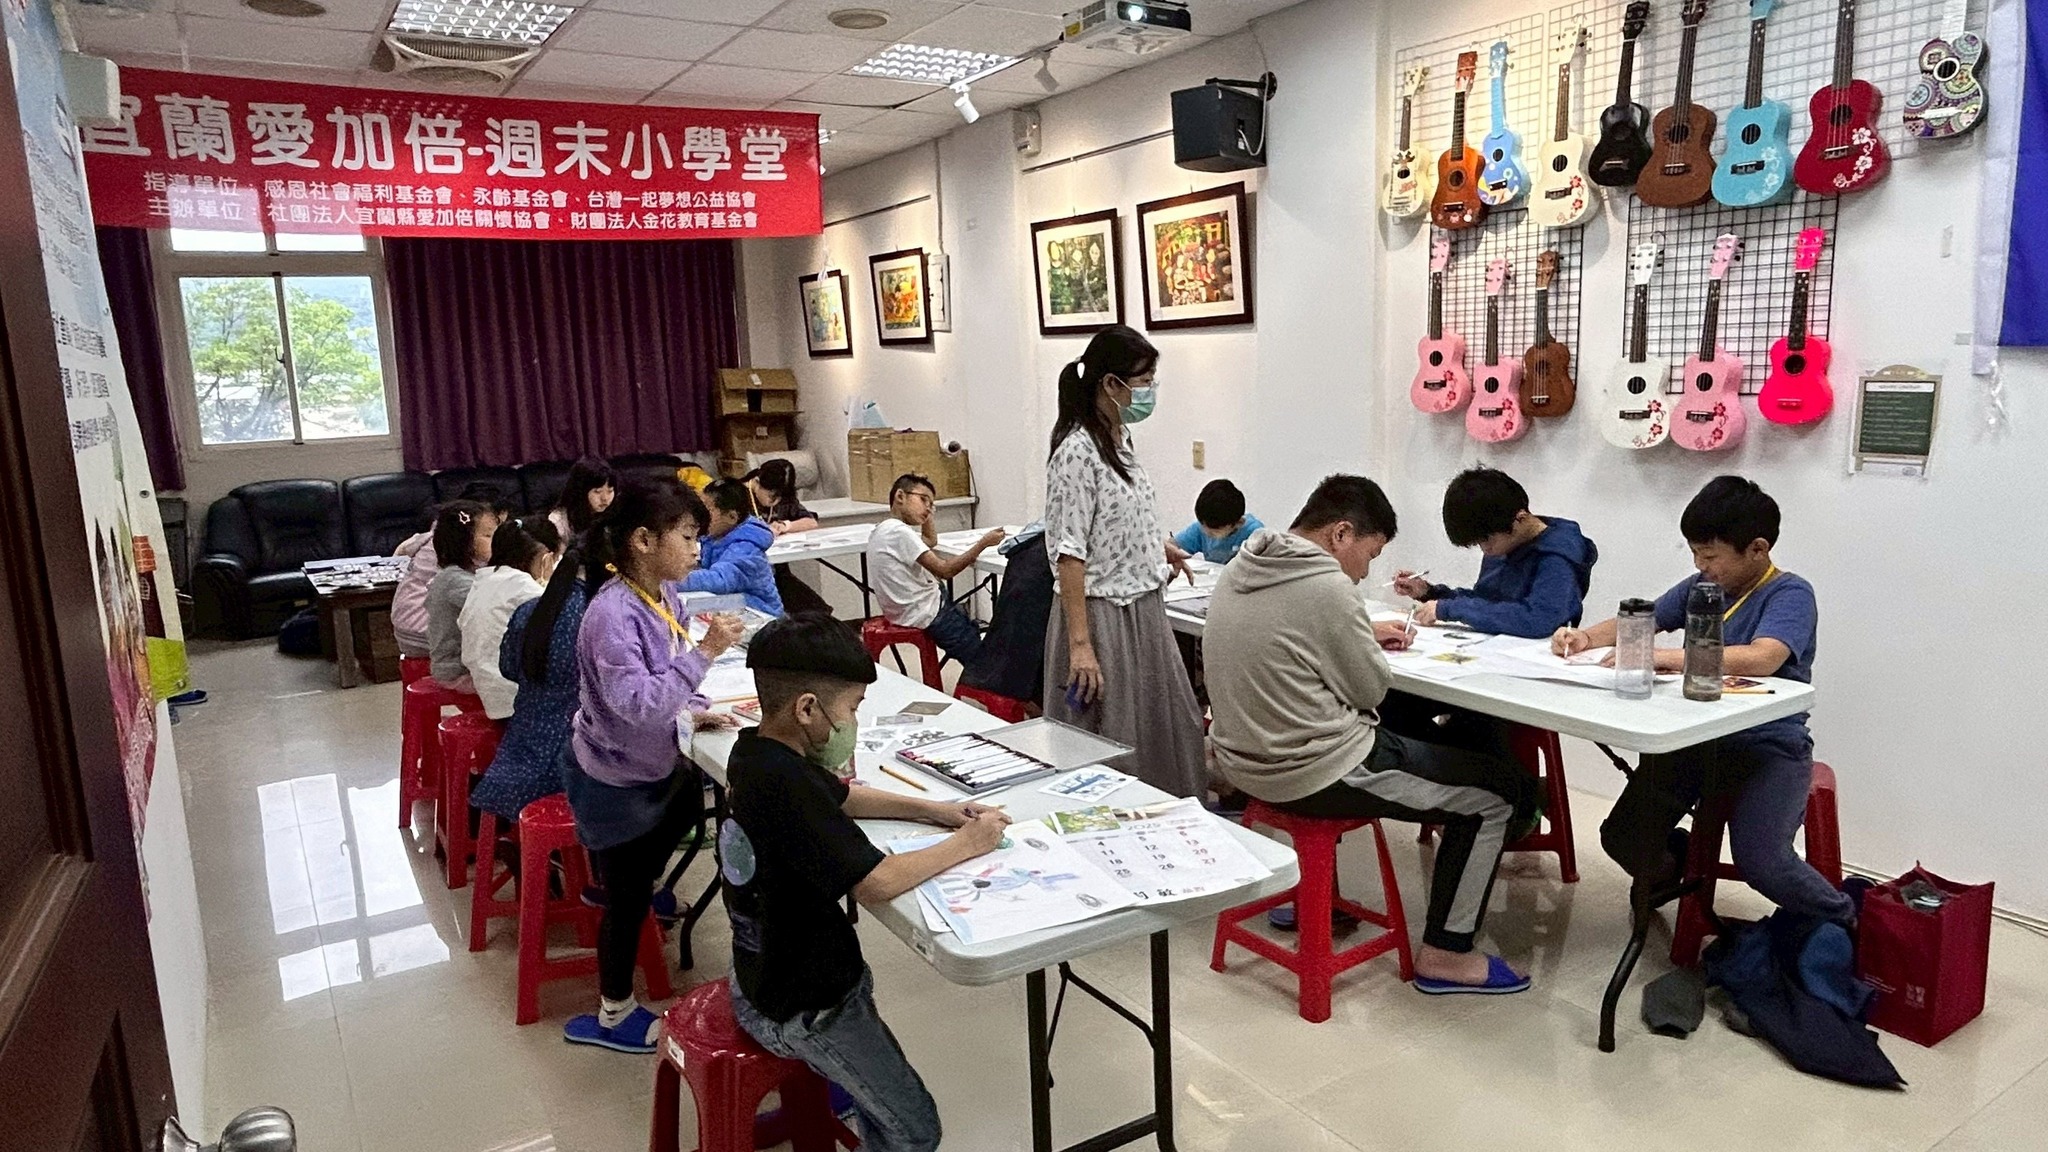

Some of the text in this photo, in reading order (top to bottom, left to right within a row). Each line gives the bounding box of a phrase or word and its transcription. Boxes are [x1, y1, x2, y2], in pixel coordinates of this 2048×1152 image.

[1152, 853, 1166, 861] 19
[1115, 857, 1217, 876] 25 26 27
